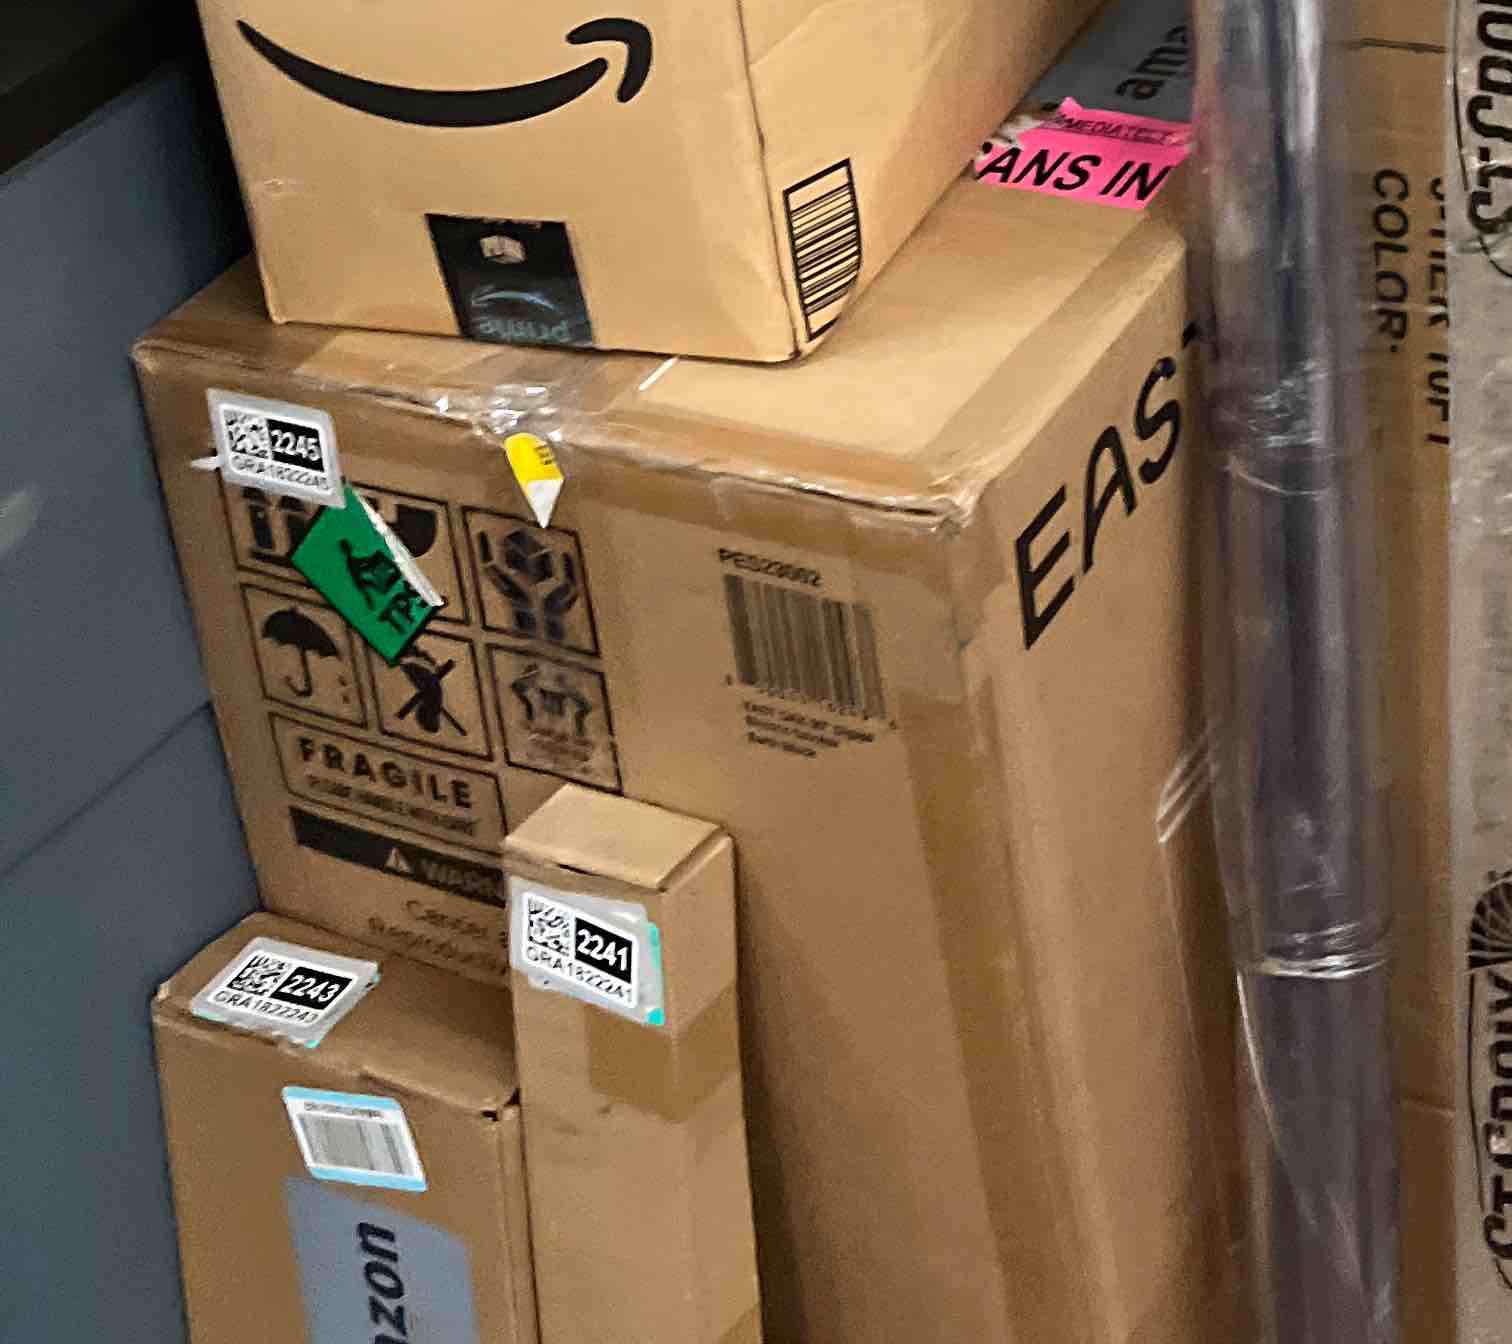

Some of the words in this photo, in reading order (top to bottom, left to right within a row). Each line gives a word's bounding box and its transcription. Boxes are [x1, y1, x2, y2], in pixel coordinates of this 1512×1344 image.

[976, 141, 1101, 194] ANS
[1108, 159, 1172, 202] IN
[271, 428, 321, 462] 2245
[1014, 320, 1206, 650] EAS
[299, 736, 473, 809] FRAGILE
[576, 928, 630, 972] 2241
[284, 972, 341, 1002] 2243
